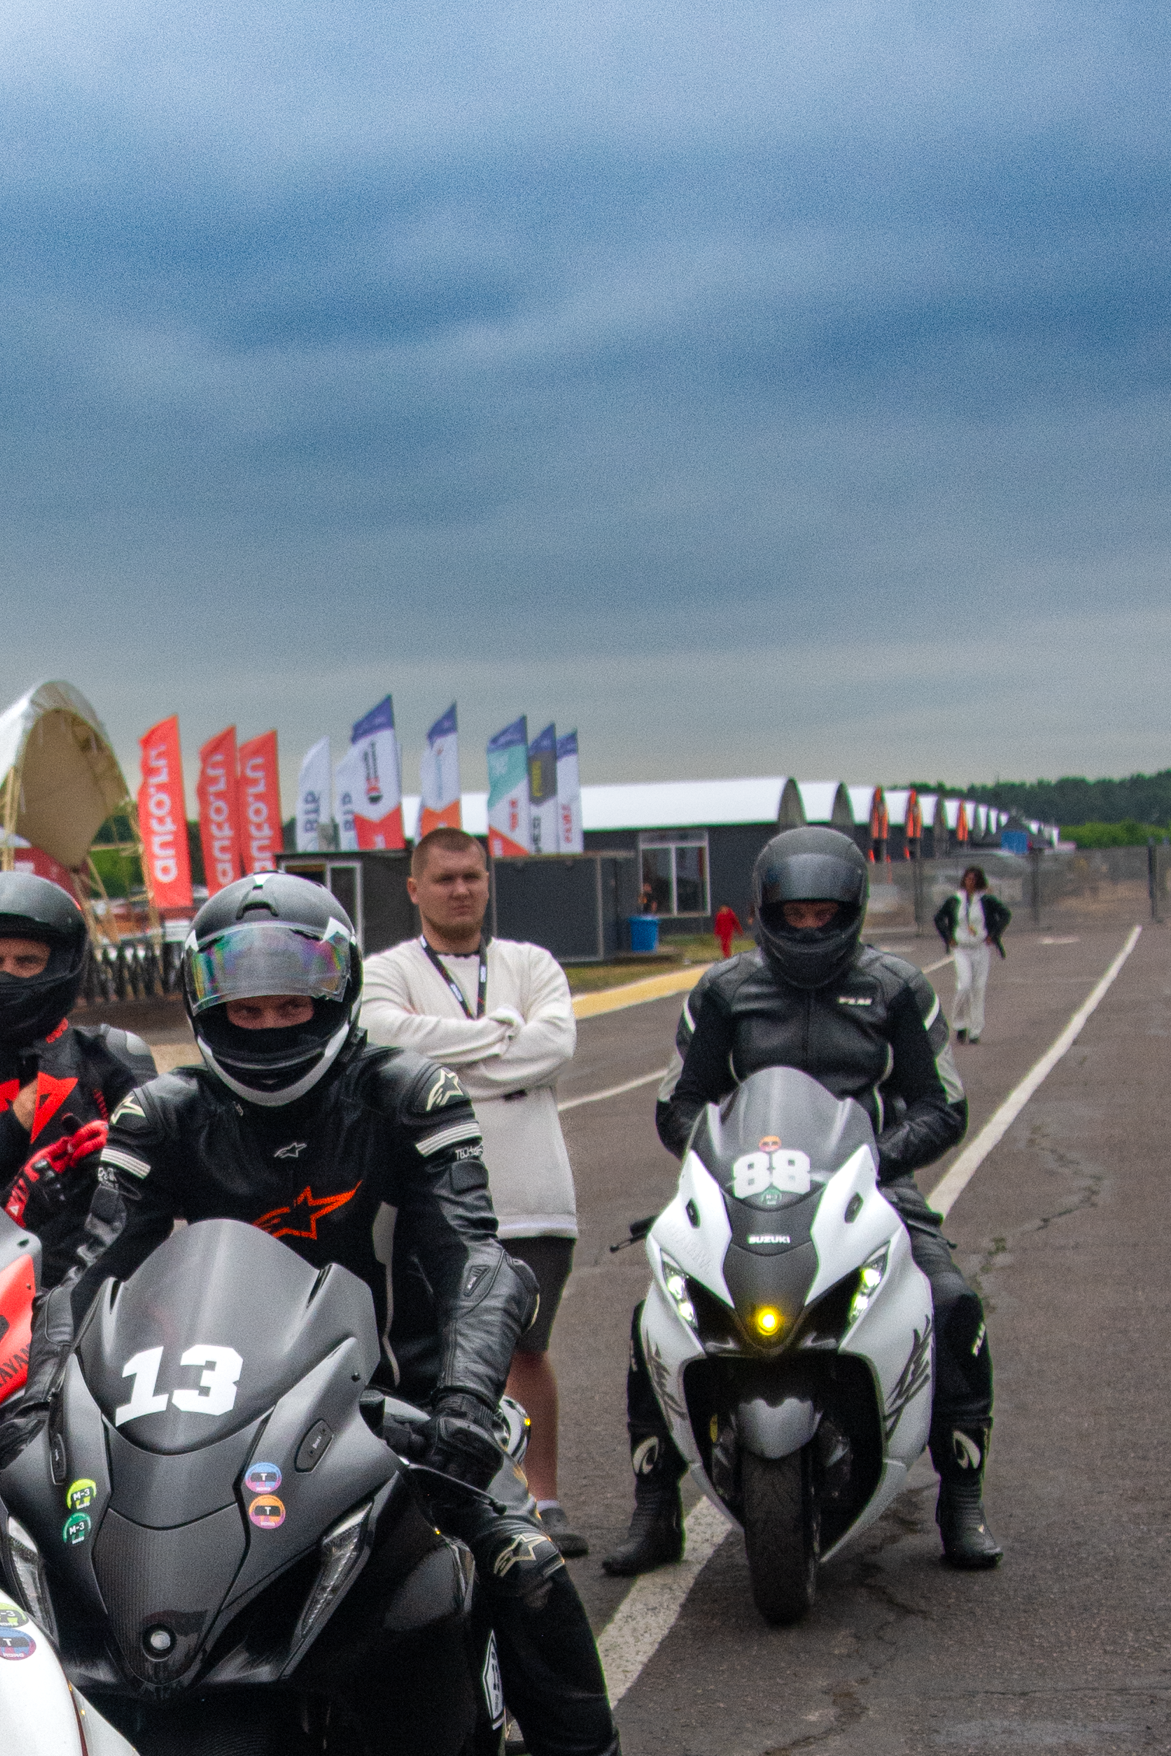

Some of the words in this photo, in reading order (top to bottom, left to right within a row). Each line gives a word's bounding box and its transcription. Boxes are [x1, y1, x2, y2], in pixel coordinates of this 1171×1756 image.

[733, 1149, 810, 1199] 88
[748, 1235, 791, 1244] SUZUKI
[115, 1344, 244, 1427] 13
[260, 1473, 267, 1481] T
[73, 1488, 90, 1501] M-3
[264, 1506, 272, 1515] T
[69, 1521, 85, 1535] M-3
[2, 1638, 12, 1647] T
